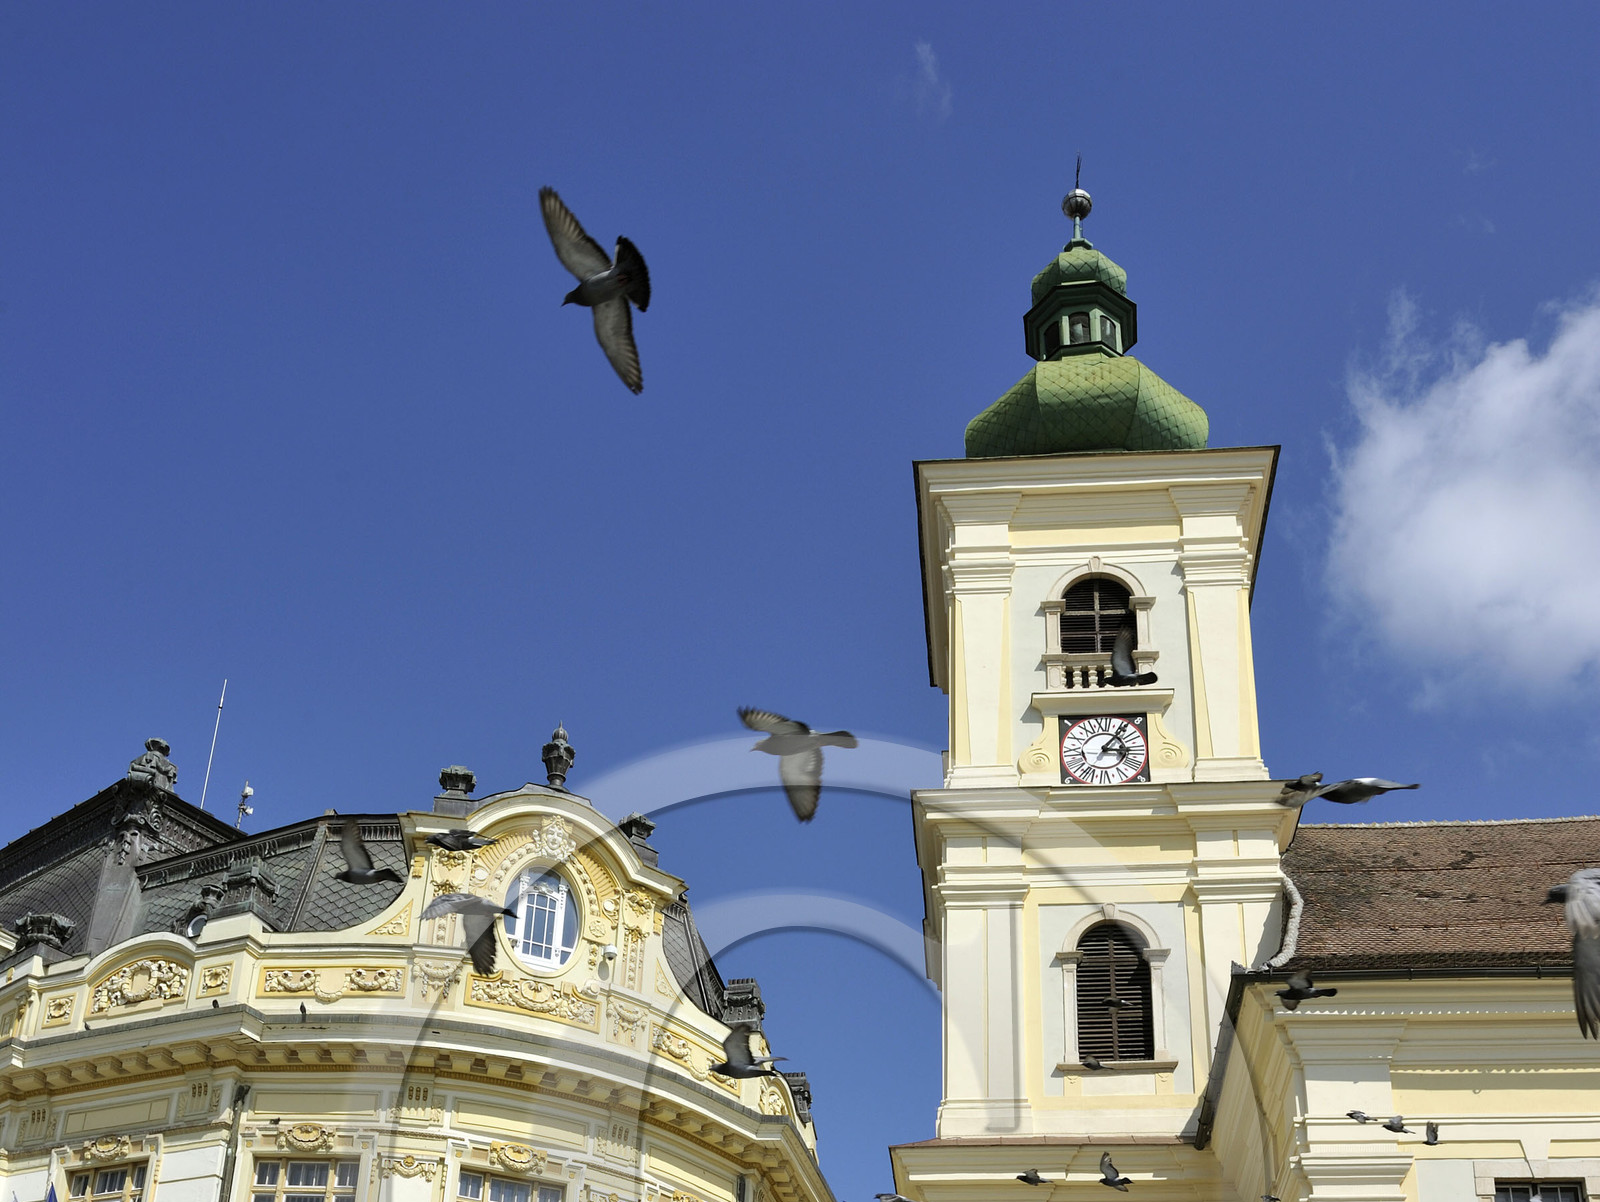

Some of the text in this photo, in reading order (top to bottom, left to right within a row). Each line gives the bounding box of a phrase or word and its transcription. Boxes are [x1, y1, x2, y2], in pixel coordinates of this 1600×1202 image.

[1095, 717, 1112, 732] XII
[1134, 716, 1143, 724] 8
[1078, 720, 1095, 737] XI
[1067, 732, 1085, 745] X
